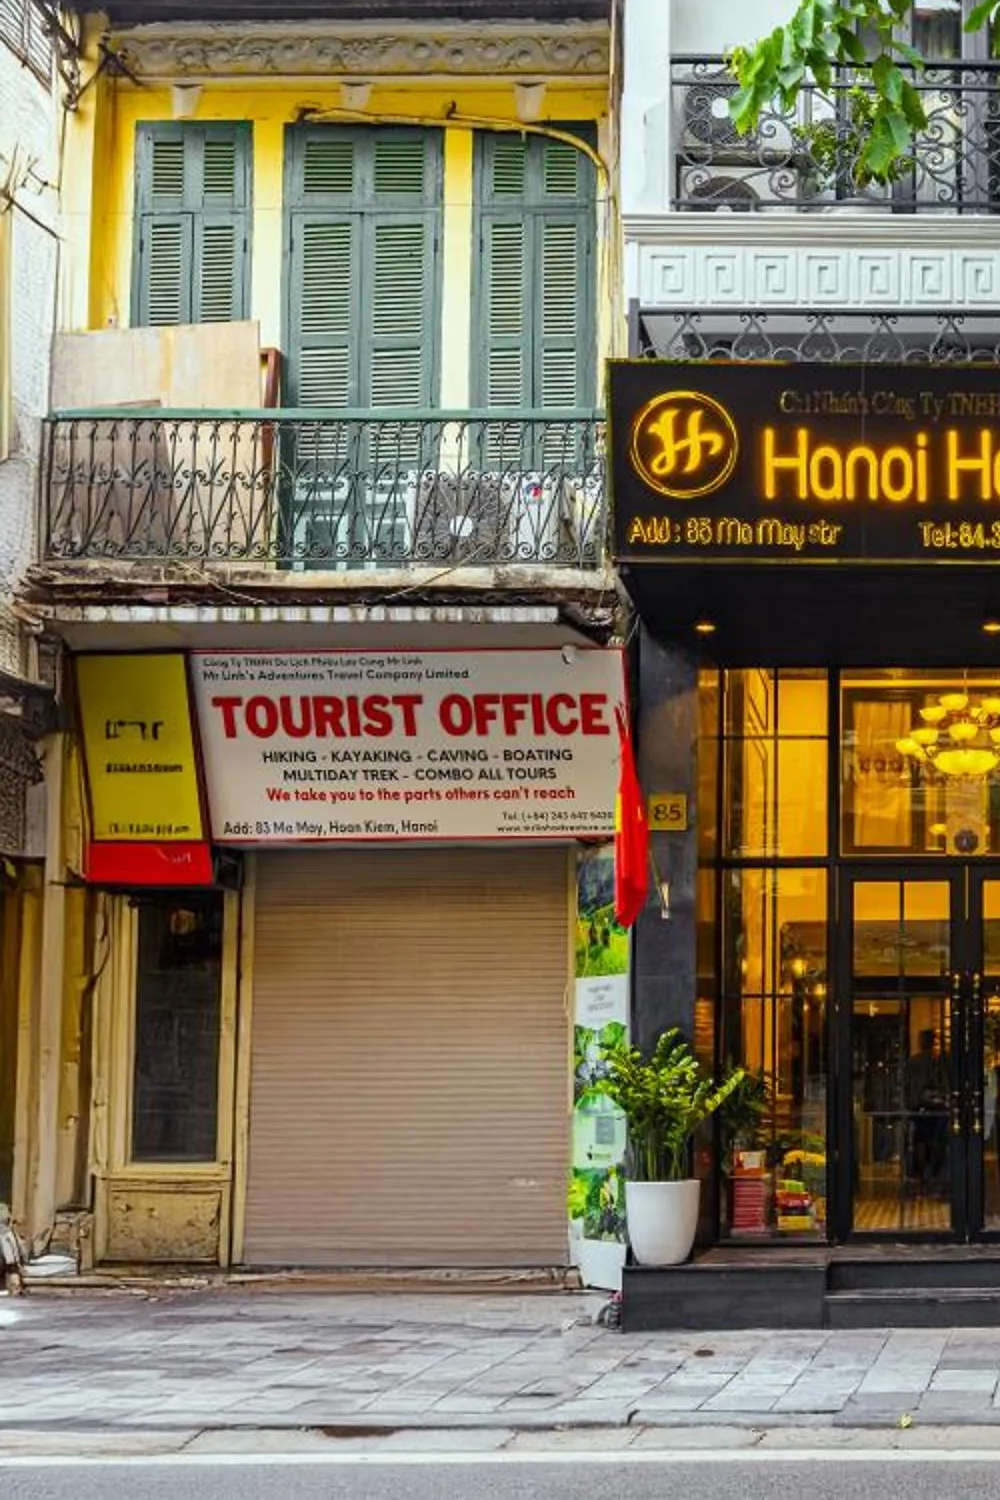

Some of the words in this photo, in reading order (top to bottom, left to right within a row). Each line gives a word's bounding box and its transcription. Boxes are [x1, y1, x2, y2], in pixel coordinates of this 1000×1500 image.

[920, 391, 942, 421] Ty
[763, 427, 928, 502] Hanoi
[203, 671, 218, 682] Mr
[222, 670, 255, 682] Linh's
[258, 669, 325, 682] Adventures
[328, 669, 362, 681] Travel
[366, 668, 422, 683] Company
[425, 668, 469, 680] Limited
[212, 694, 423, 739] TOURIST
[439, 693, 611, 737] OFFICE
[262, 750, 317, 764] HIKING
[331, 750, 412, 763] KAYAKING
[427, 749, 488, 762] CAVING
[503, 749, 573, 761] BOATING
[283, 769, 358, 781] MULTIDAY
[362, 769, 399, 781] TREK
[415, 768, 473, 781] COMBO
[478, 768, 503, 780] ALL
[507, 767, 557, 780] TOURS
[266, 788, 291, 802] We
[294, 788, 327, 801] take
[329, 790, 357, 804] you
[359, 788, 375, 801] to
[377, 787, 401, 801] the
[404, 787, 441, 804] parts
[445, 786, 490, 800] others
[493, 786, 529, 800] can't
[534, 787, 575, 800] reach
[653, 803, 682, 822] 85
[223, 821, 253, 835] Add:
[273, 821, 293, 834] Ma
[295, 821, 327, 836] May,
[329, 820, 362, 834] Hoan
[401, 819, 438, 833] Hanoi
